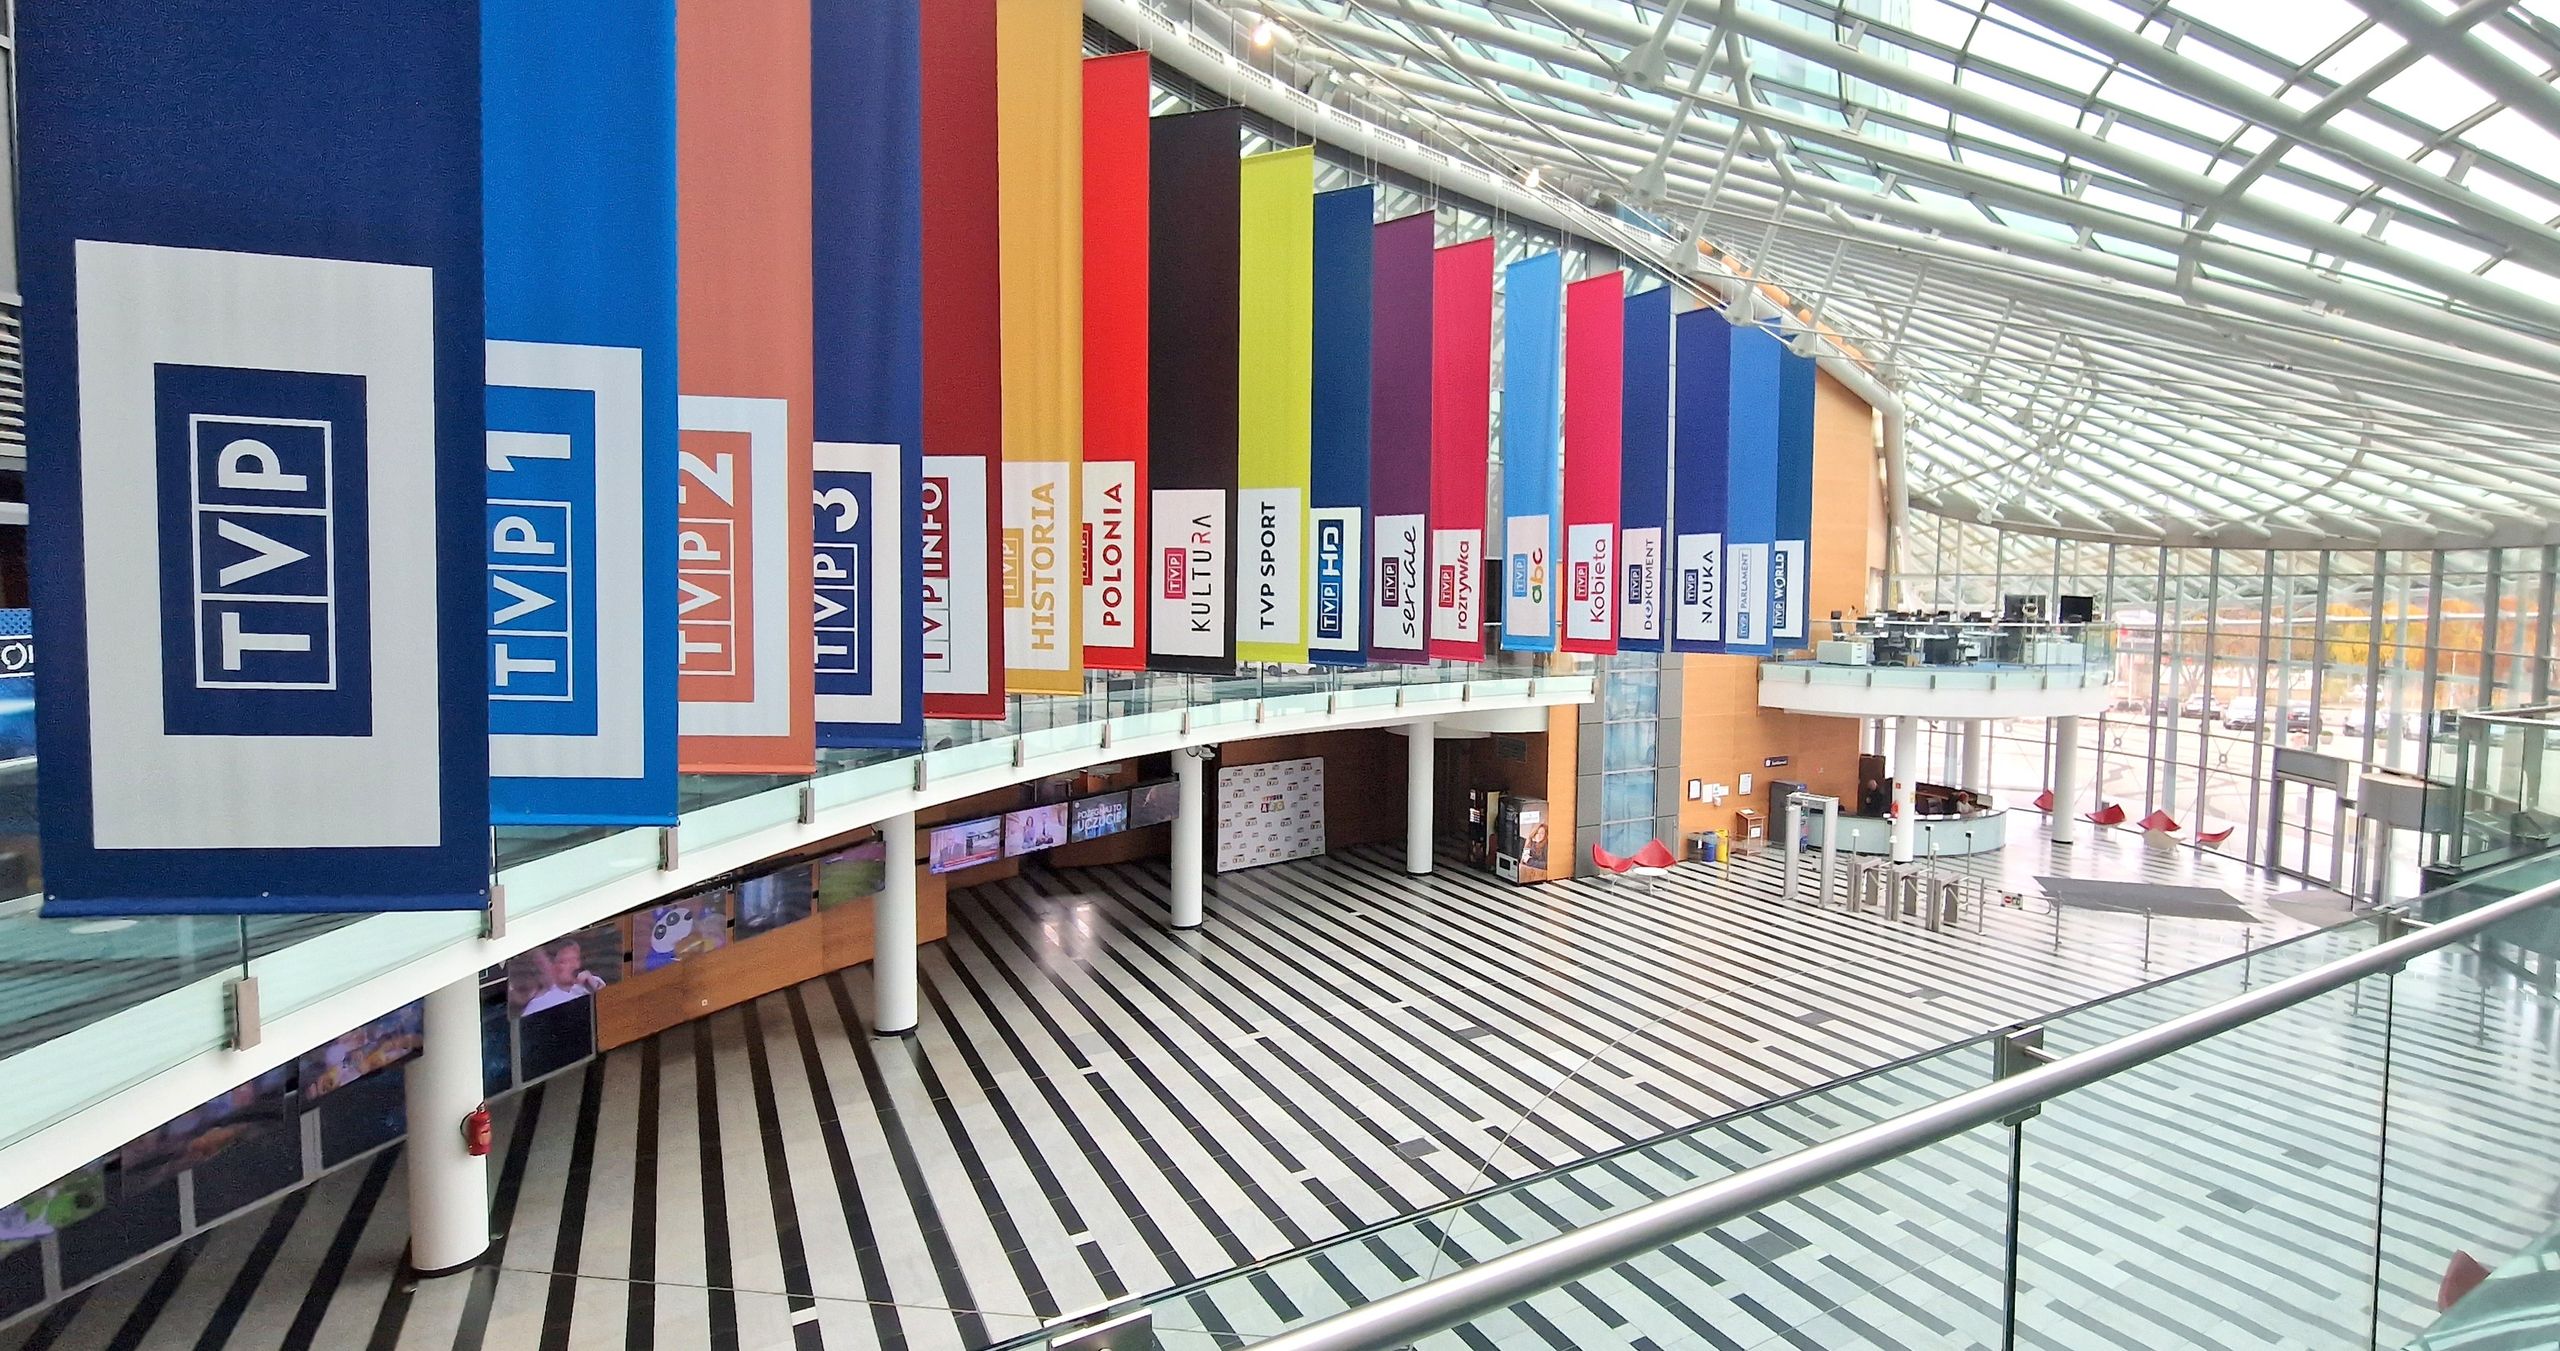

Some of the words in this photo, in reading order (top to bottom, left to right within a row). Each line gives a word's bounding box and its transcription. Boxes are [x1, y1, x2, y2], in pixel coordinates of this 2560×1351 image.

[485, 430, 571, 472] 1
[678, 450, 734, 507] 2
[812, 487, 859, 533] 3
[922, 481, 943, 572] INFO
[218, 438, 311, 671] TVP
[1031, 482, 1055, 651] HISTORIA
[1102, 482, 1123, 627] POLONIA
[1260, 501, 1276, 577] SPORT
[1320, 526, 1340, 576] HD
[493, 515, 557, 687] TVP
[678, 530, 722, 665] TVP
[1169, 555, 1181, 592] TVP
[1191, 514, 1212, 632] KULTURA
[1385, 565, 1397, 599] TVP
[1402, 526, 1417, 639] seriale
[1442, 571, 1452, 600] TVP
[1457, 541, 1472, 630] rozrywka
[1516, 561, 1525, 591] TVP
[1530, 547, 1544, 603] abc
[1576, 567, 1587, 596] TVP
[1590, 539, 1607, 623] Kobieta
[1631, 570, 1640, 599] TVP
[1644, 539, 1654, 631] DOKUMENT
[1687, 574, 1696, 600] TVP
[1701, 550, 1714, 624] NAUKA
[1740, 552, 1749, 609] PARLAMENT
[1774, 553, 1786, 599] WORLD
[813, 553, 848, 664] TVP
[1260, 583, 1275, 630] TVP
[1323, 586, 1337, 628] TVP
[1776, 603, 1785, 626] TVP
